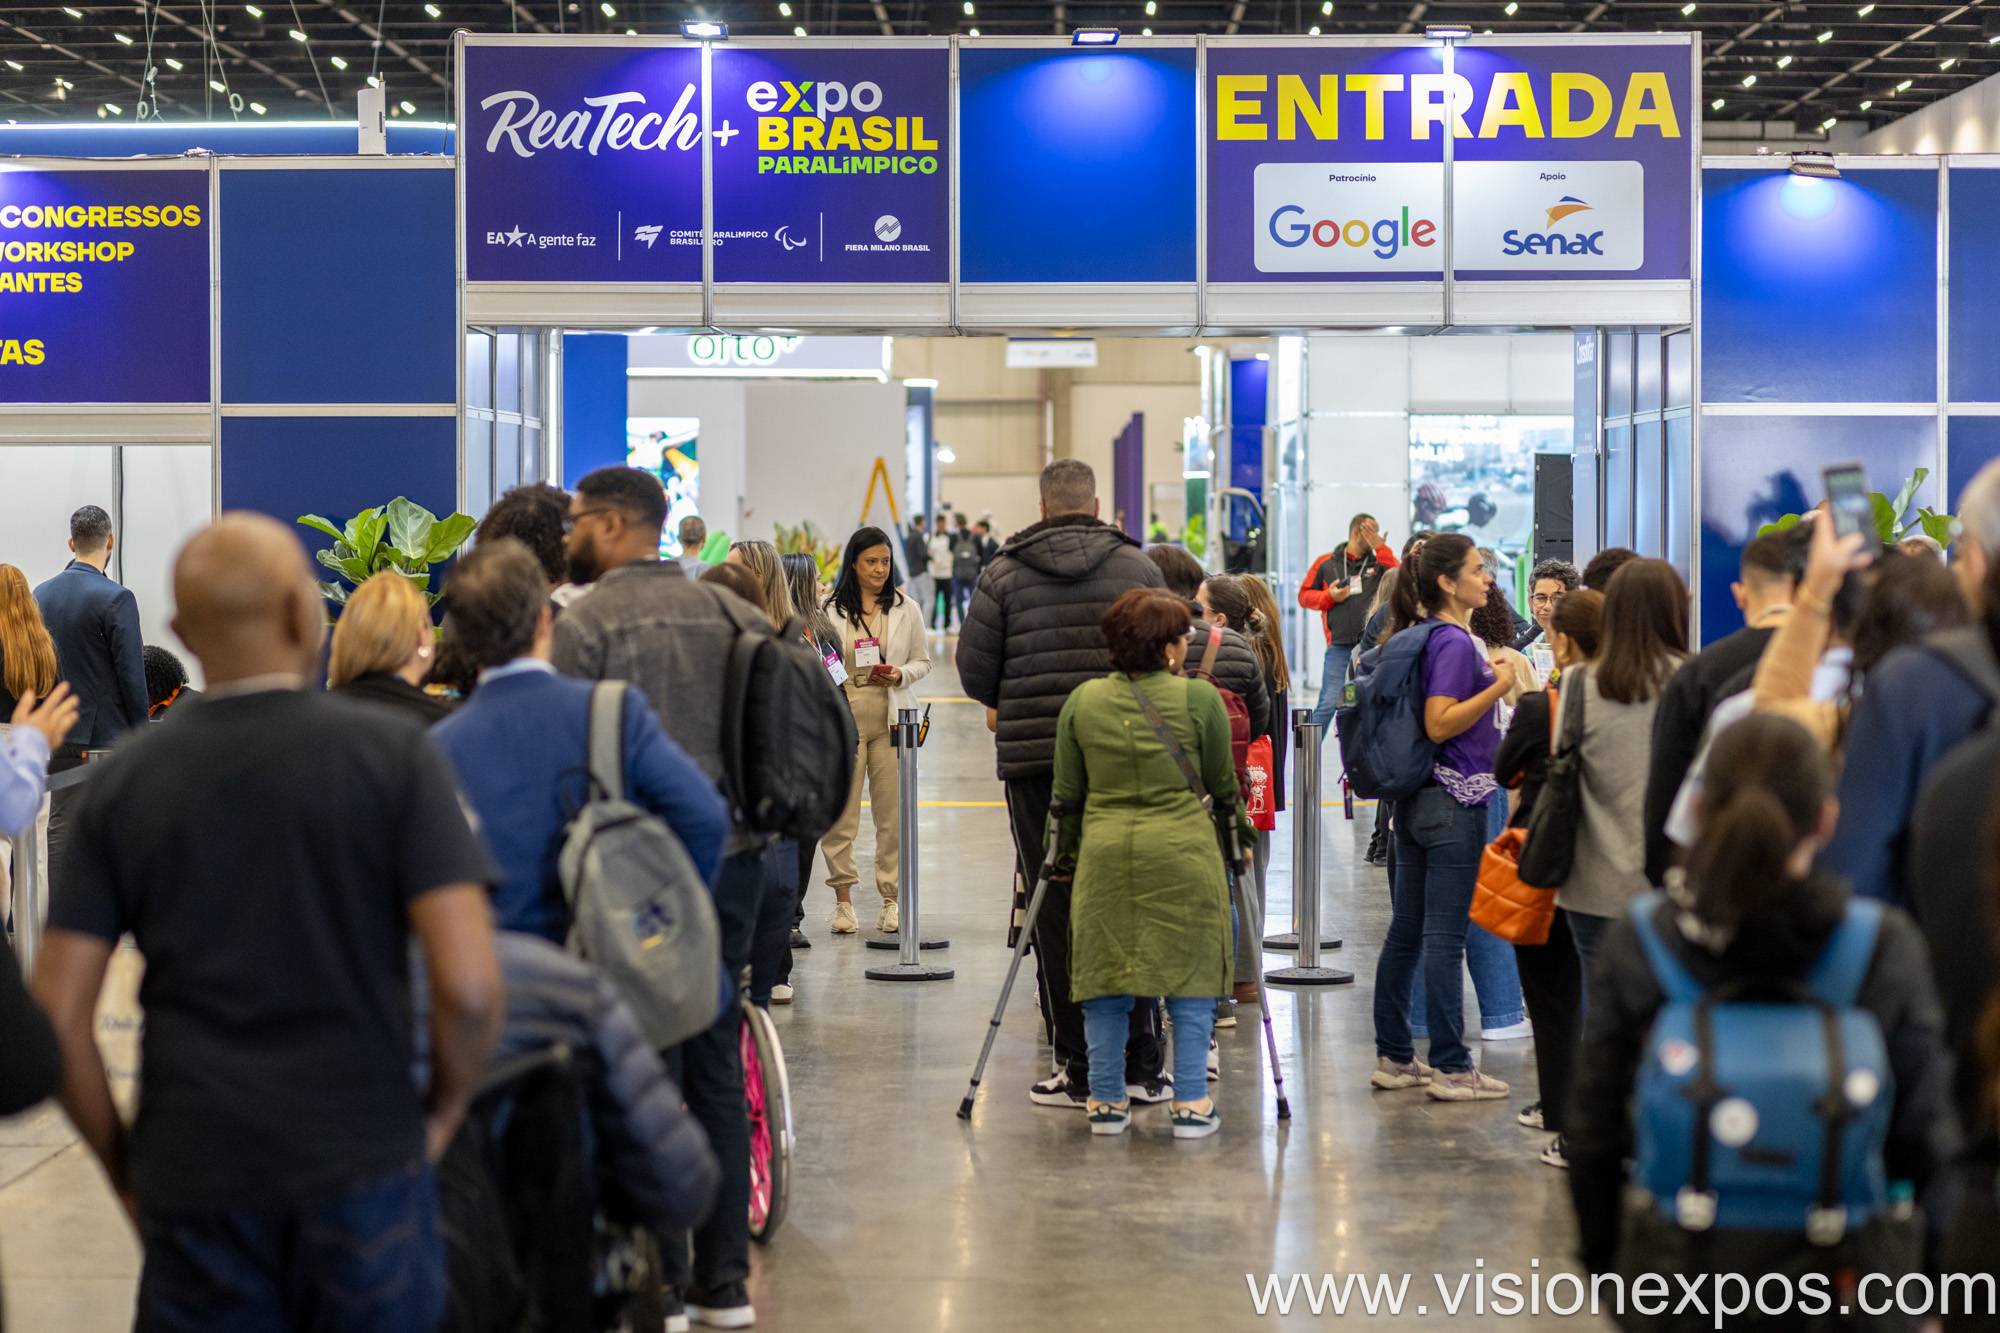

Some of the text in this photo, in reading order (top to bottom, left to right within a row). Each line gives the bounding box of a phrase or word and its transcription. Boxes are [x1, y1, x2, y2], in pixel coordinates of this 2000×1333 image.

[746, 80, 883, 121] expo
[1216, 71, 1681, 141] ENTRADA
[481, 82, 702, 158] ReaTech
[758, 116, 938, 152] BRASIL
[1539, 172, 1567, 182] Apoio
[0, 204, 201, 229] CONGRESSOS
[526, 233, 537, 245] A
[539, 234, 574, 249] gente
[576, 232, 597, 246] faz
[1269, 205, 1436, 260] Google
[1502, 229, 1604, 256] Senac
[844, 244, 931, 252] FIERA MILANO BRASIL
[0, 338, 46, 366] AS
